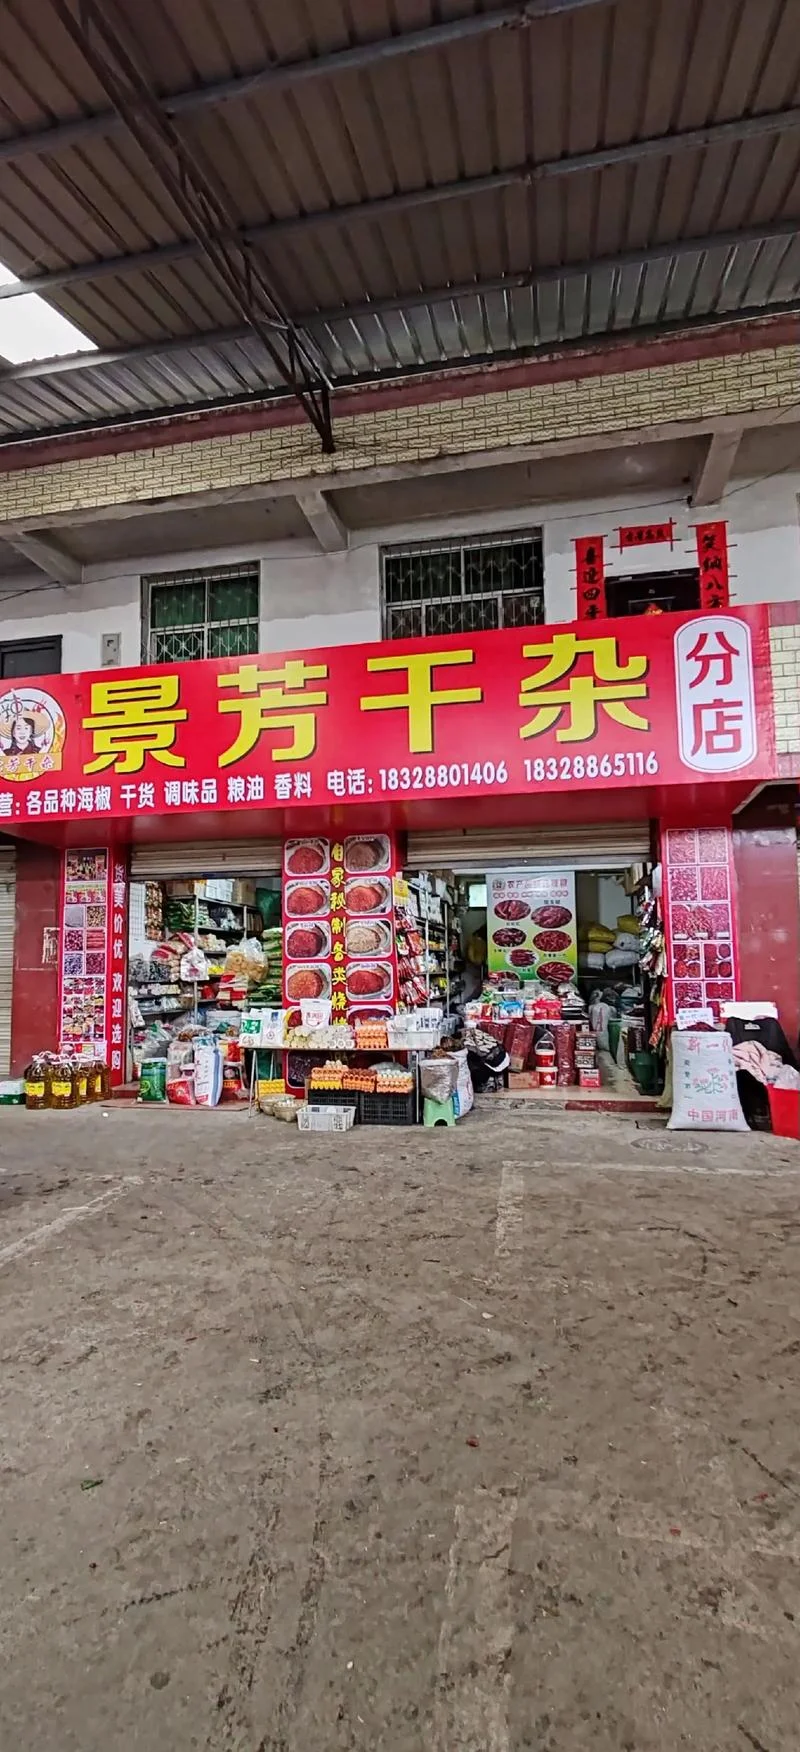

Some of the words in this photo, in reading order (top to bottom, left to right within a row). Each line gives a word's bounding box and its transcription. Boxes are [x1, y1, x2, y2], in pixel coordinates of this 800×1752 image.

[82, 633, 650, 775] 景芳干杂
[685, 631, 744, 757] 分店
[120, 783, 155, 809] 干货
[164, 778, 217, 805] 调味品
[227, 775, 264, 802] 粮油
[274, 771, 312, 799] 香料
[524, 751, 659, 783] 18328865116
[687, 1108, 738, 1122] 中国河南
